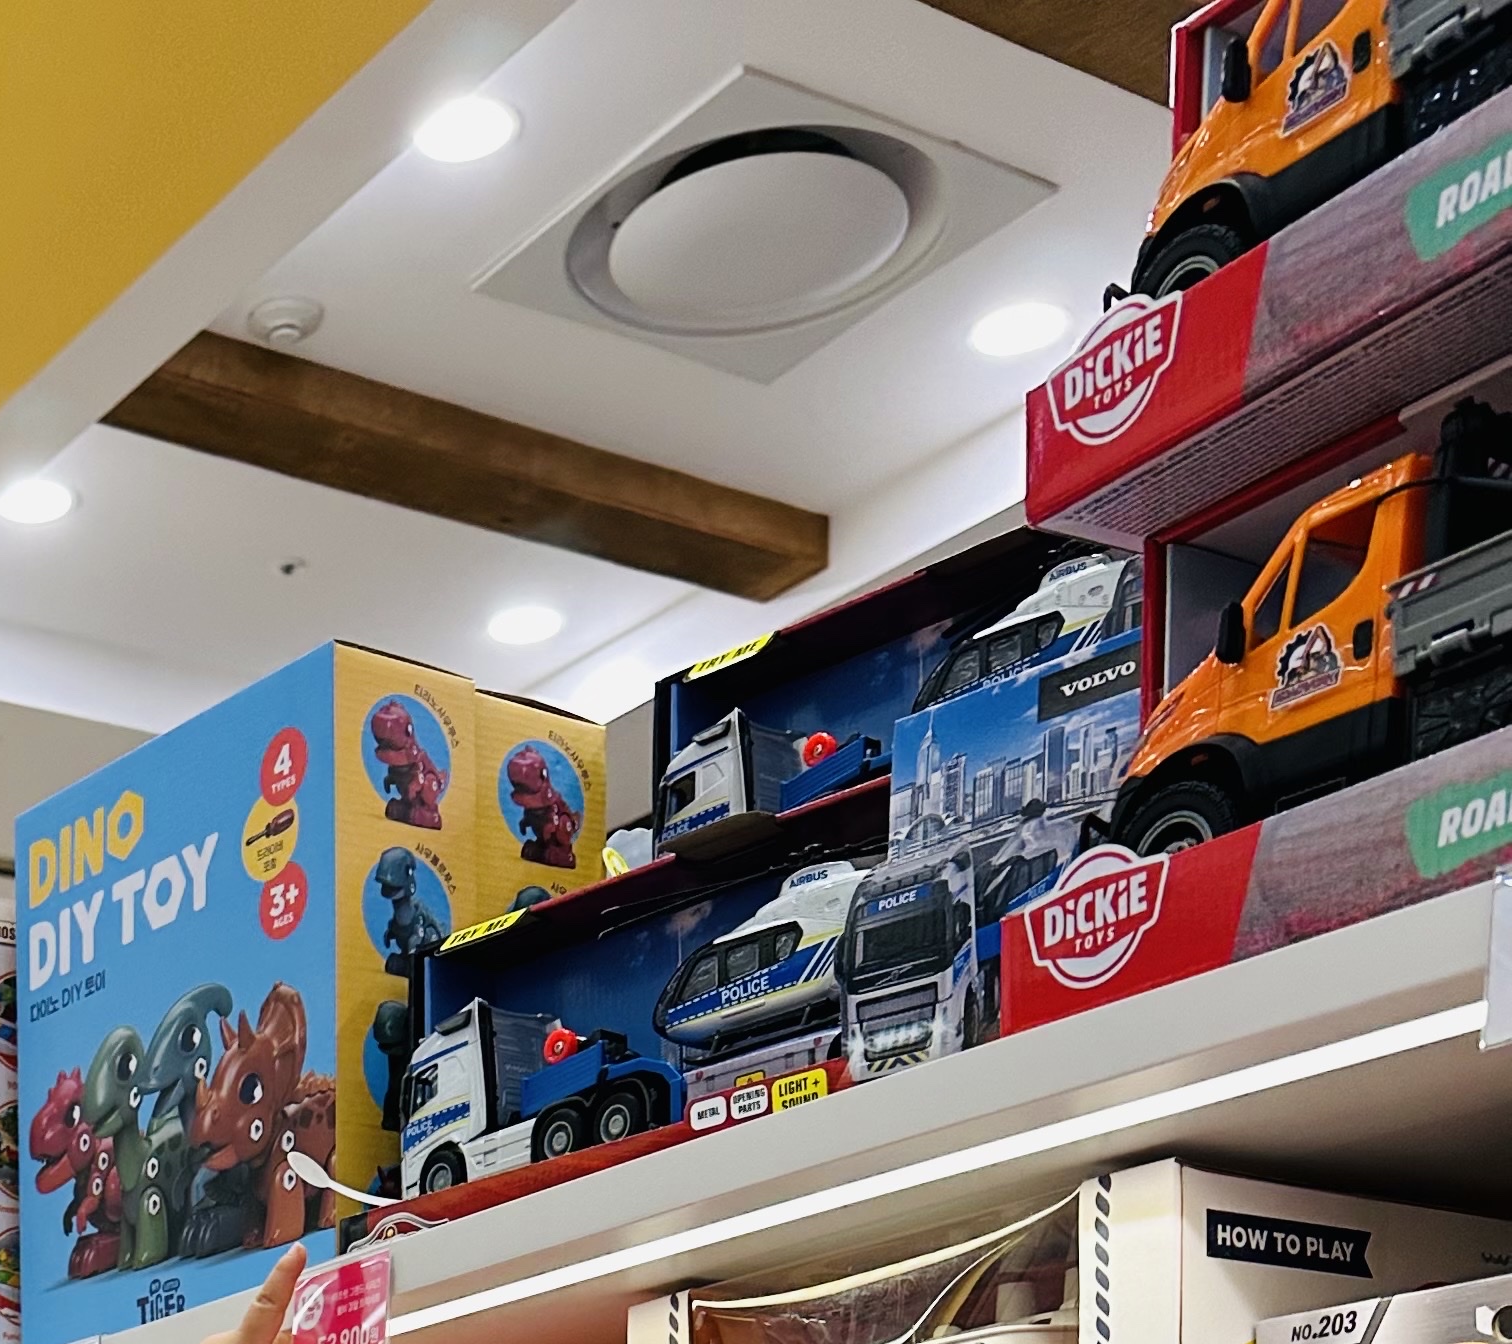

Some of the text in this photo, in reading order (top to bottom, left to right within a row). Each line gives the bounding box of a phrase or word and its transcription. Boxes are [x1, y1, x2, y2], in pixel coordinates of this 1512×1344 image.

[1094, 376, 1132, 407] TOYS
[1048, 561, 1087, 583] AIRBUS
[698, 640, 760, 671] TRY ME
[1060, 661, 1136, 696] VOLVO
[273, 744, 292, 776] 4
[272, 775, 296, 794] TYPES
[29, 790, 144, 909] DINO
[789, 870, 828, 888] AIRBUS
[29, 832, 219, 991] DIY TOY
[270, 884, 300, 918] 3+
[878, 890, 917, 910] POLICE
[273, 912, 294, 930] AGES
[450, 915, 512, 946] TRY ME
[1074, 927, 1116, 953] TOYS
[30, 969, 106, 1022] 다이노 DIY 토이
[722, 976, 770, 1003] POLICE
[779, 1078, 820, 1096] LIGHT +
[698, 1106, 720, 1120] METAL
[738, 1101, 761, 1114] PARTS
[406, 1119, 433, 1136] POLICE
[1217, 1224, 1354, 1262] HOW TO PLAY
[1291, 1311, 1357, 1342] NO.203
